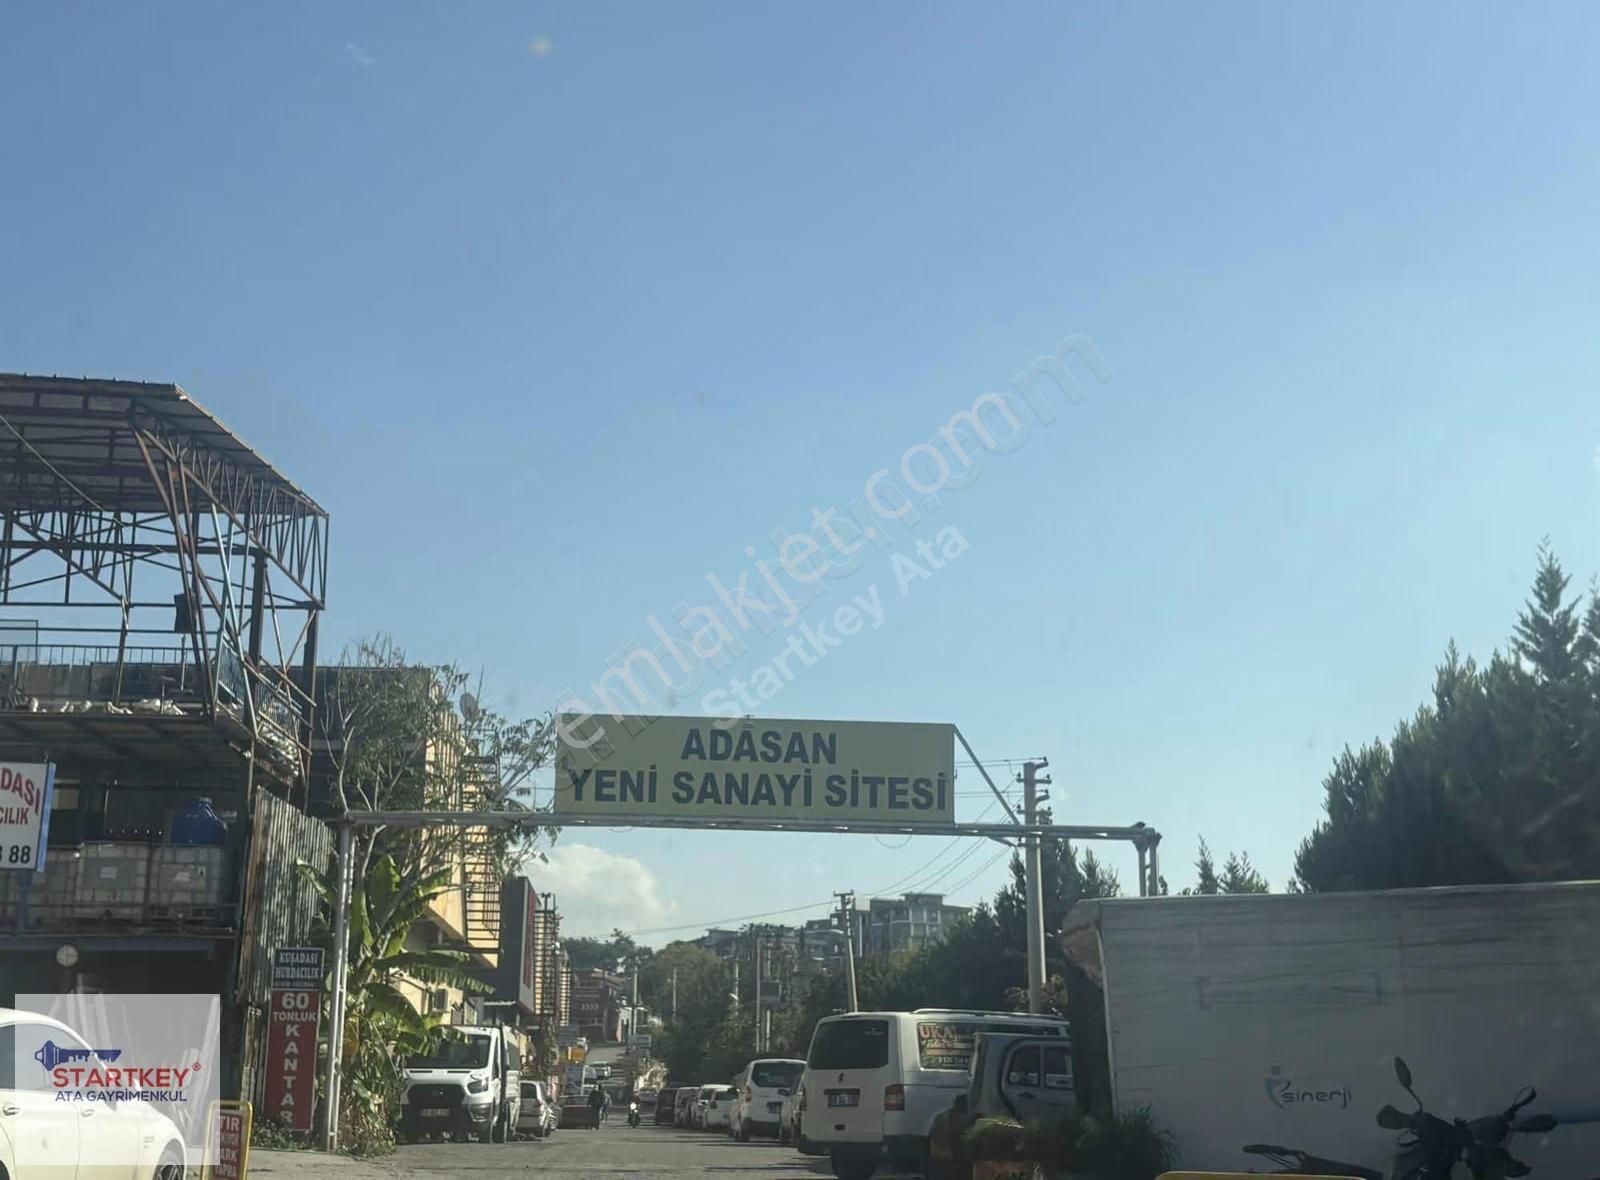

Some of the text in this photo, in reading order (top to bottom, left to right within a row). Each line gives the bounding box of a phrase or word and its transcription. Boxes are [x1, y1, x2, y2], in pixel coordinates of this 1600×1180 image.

[681, 728, 837, 765] ADASAN
[566, 764, 946, 810] YENİ SANAYİ SİTESİ
[282, 992, 309, 1009] 60
[272, 1011, 316, 1022] TONLUK
[280, 1024, 300, 1124] KANTAR
[1280, 1085, 1352, 1110] sinerji
